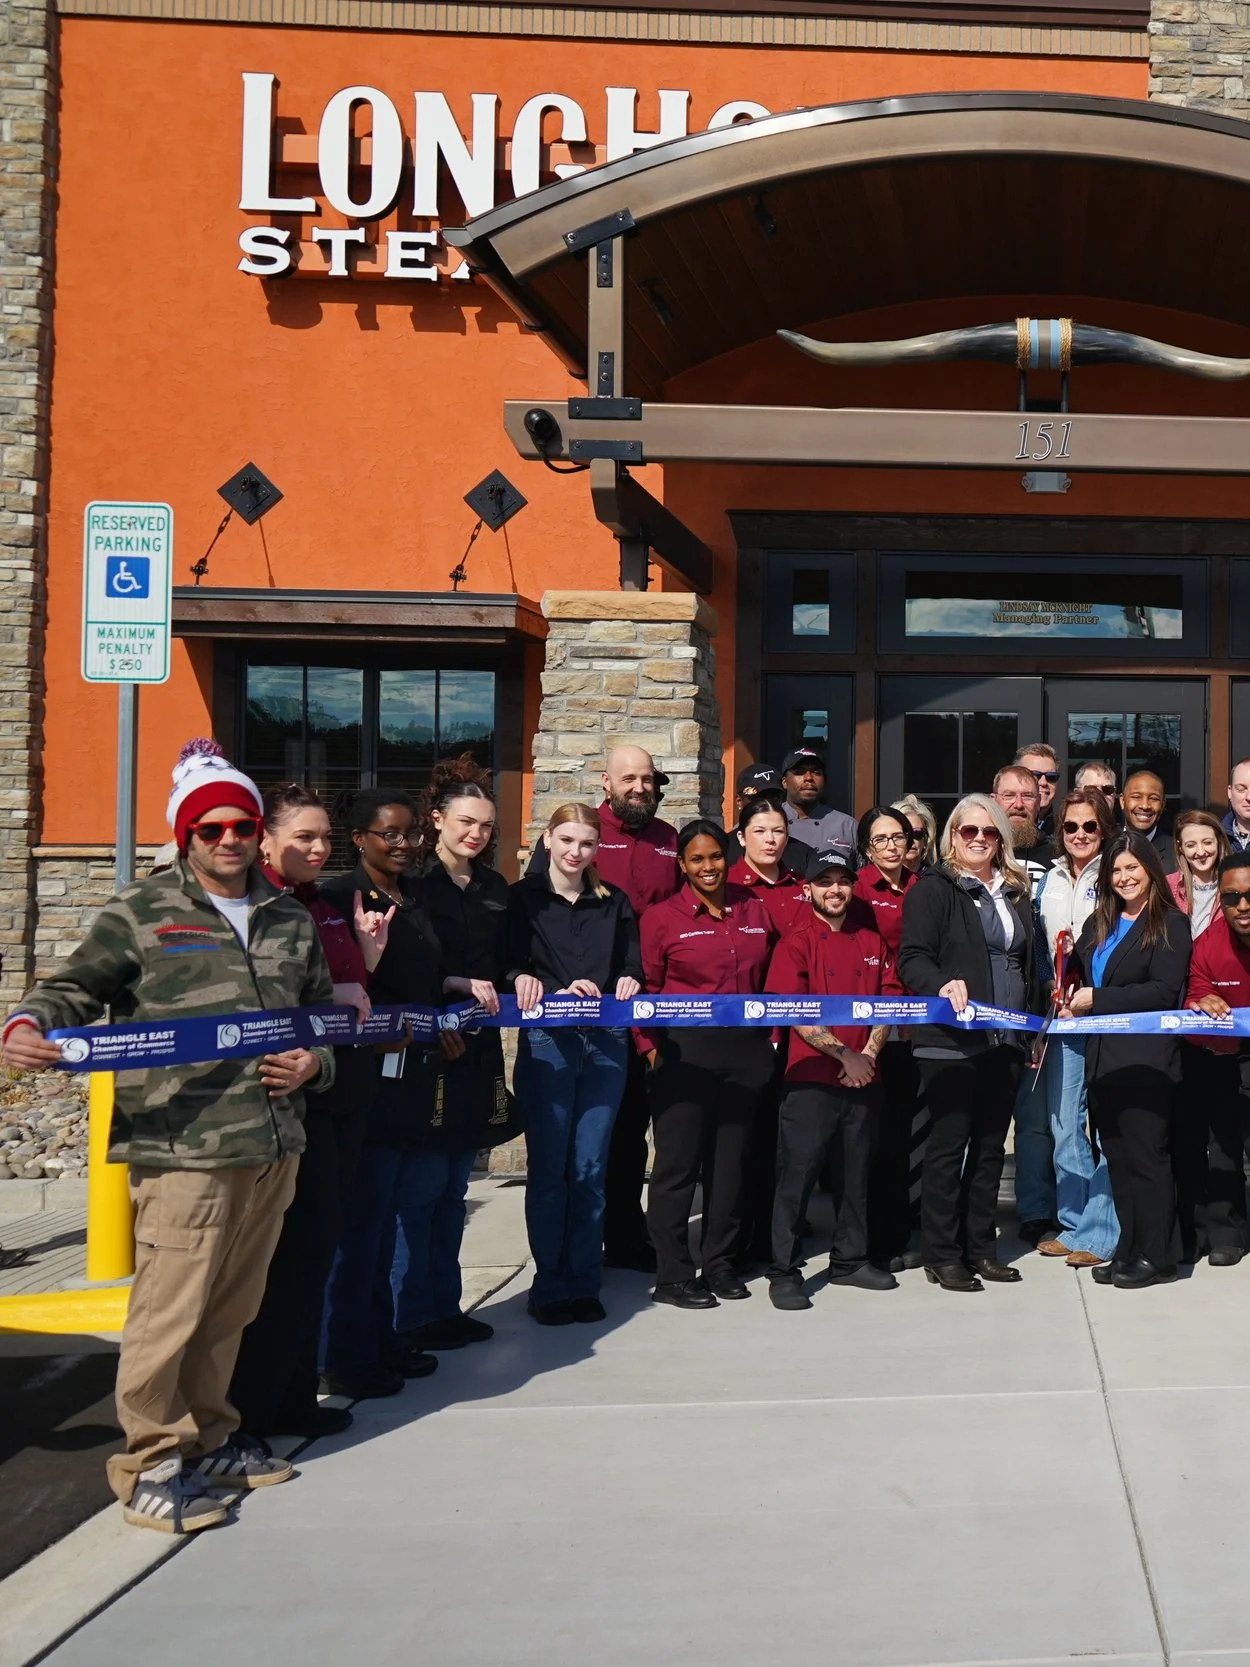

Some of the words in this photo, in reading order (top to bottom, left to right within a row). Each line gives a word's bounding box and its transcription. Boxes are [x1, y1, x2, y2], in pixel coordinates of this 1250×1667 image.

[238, 71, 772, 218] LONGH
[237, 226, 473, 282] STE
[1015, 421, 1072, 460] 151
[91, 515, 165, 531] RESERVED
[95, 536, 161, 551] PARKING
[1000, 602, 1039, 612] LINDSAY
[993, 613, 1050, 625] Managing
[1054, 614, 1099, 624] Partner
[97, 628, 155, 639] MAXIMUM
[99, 643, 152, 655] PENALTY
[976, 1006, 1010, 1016] TRIANGLE
[1011, 1012, 1028, 1020] EAST
[242, 1020, 279, 1031] TRIANGLE
[92, 1033, 147, 1045] TRIANGLE
[149, 1030, 176, 1040] EAST
[242, 1030, 266, 1038] Chamber
[92, 1045, 126, 1053] Chamber
